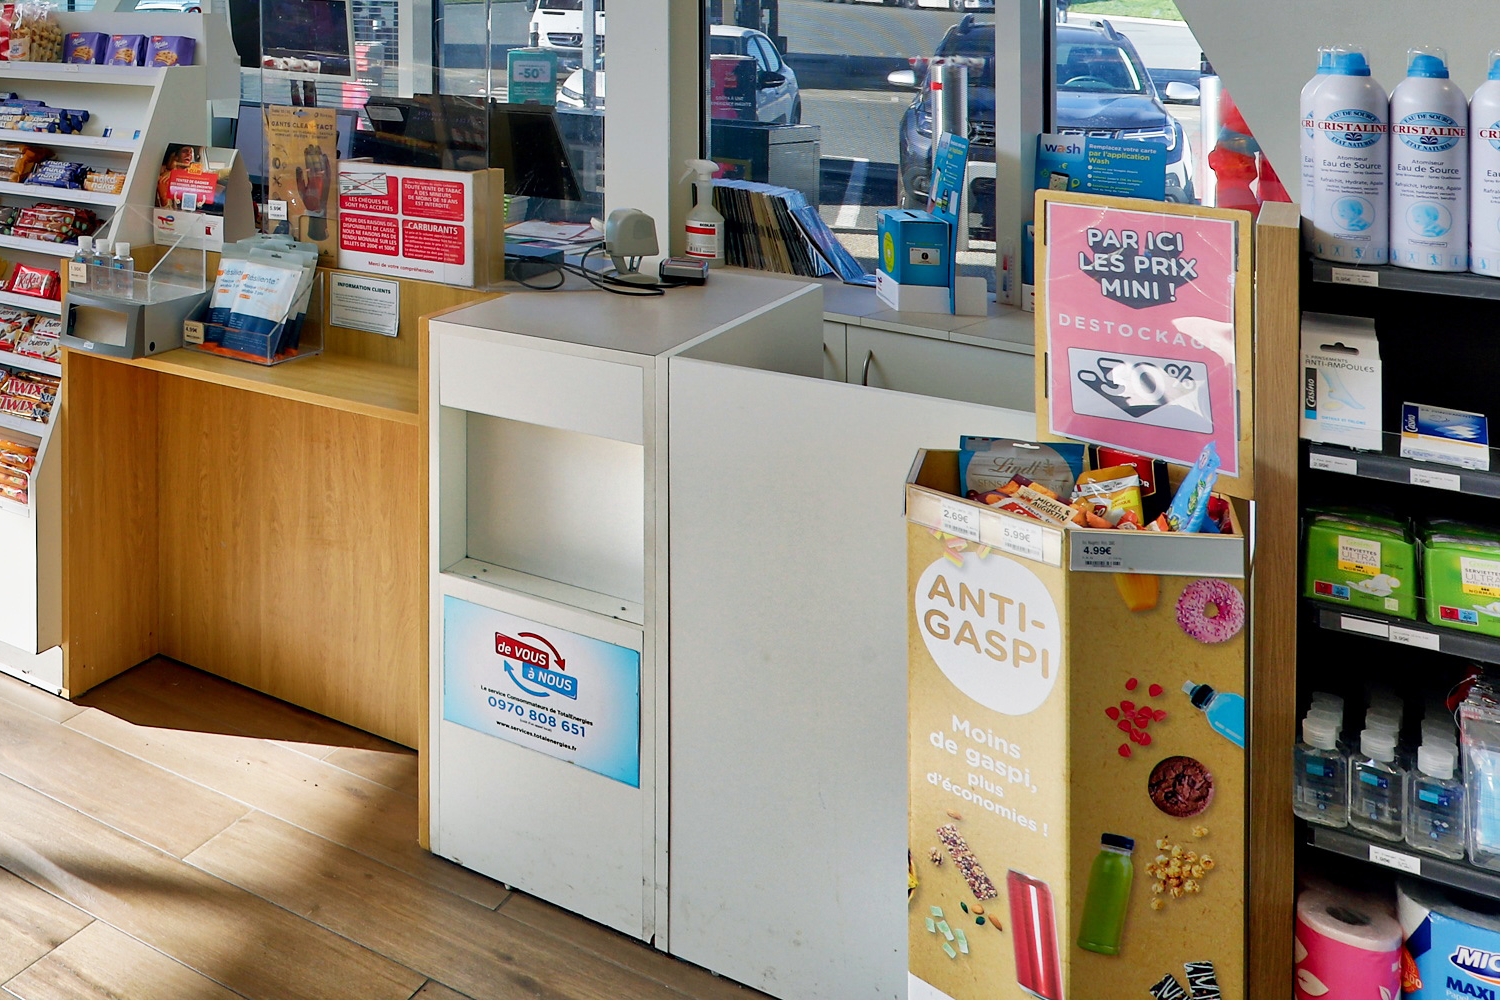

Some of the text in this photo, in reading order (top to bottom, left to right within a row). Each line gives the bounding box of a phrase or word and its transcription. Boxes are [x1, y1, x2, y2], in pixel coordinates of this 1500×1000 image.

[270, 120, 290, 128] GANTS
[1318, 121, 1388, 132] CRISTALINE
[1392, 124, 1466, 136] CRISTALINE
[1044, 142, 1081, 154] wash
[1088, 144, 1122, 152] Remplacez
[1102, 150, 1150, 161] l'application
[1088, 157, 1110, 165] Wash
[1322, 160, 1382, 170] Eau de Source
[1397, 164, 1412, 172] Eau
[1429, 166, 1460, 174] Source
[421, 184, 436, 192] VENTE
[408, 222, 458, 234] CARBURANTS
[1086, 228, 1184, 252] PAR ICI
[400, 264, 434, 274] compréhension
[1078, 252, 1198, 278] LES PRIX
[338, 282, 370, 291] INFORMATION
[1101, 278, 1177, 302] MINI !
[28, 340, 50, 348] bueno
[1306, 359, 1374, 372] ANTI-AMPOULES
[8, 378, 44, 396] TWIX
[1306, 378, 1316, 408] Casino
[0, 394, 36, 410] TWIX
[1404, 414, 1418, 432] Casino
[988, 457, 1043, 475] Lindt
[1032, 501, 1068, 522] AUGUSTIN
[1036, 496, 1062, 512] MICHEL
[944, 508, 968, 524] 2.69€
[1004, 528, 1030, 543] 5.99€
[1084, 546, 1112, 556] 4.99€
[1342, 546, 1377, 556] SERVIETTES
[1342, 551, 1376, 562] ULTRA
[1344, 566, 1368, 574] NORMAL
[928, 574, 1046, 633] ANTI-
[924, 609, 1049, 679] GASPI
[498, 642, 547, 666] de VOUS
[528, 667, 572, 692] à NOUS
[488, 687, 506, 698] service
[506, 692, 549, 712] Consommateurs
[557, 710, 594, 726] TotalEnergies
[488, 696, 524, 717] 0970
[530, 708, 556, 728] 808
[562, 720, 586, 738] 651
[496, 720, 577, 752] www.services.totalenergies.fr
[952, 715, 1021, 759] Moins
[930, 730, 1038, 794] de gaspi,
[968, 773, 1004, 798] plus
[927, 772, 1048, 838] d'économies !
[1446, 976, 1495, 1000] MAXI
